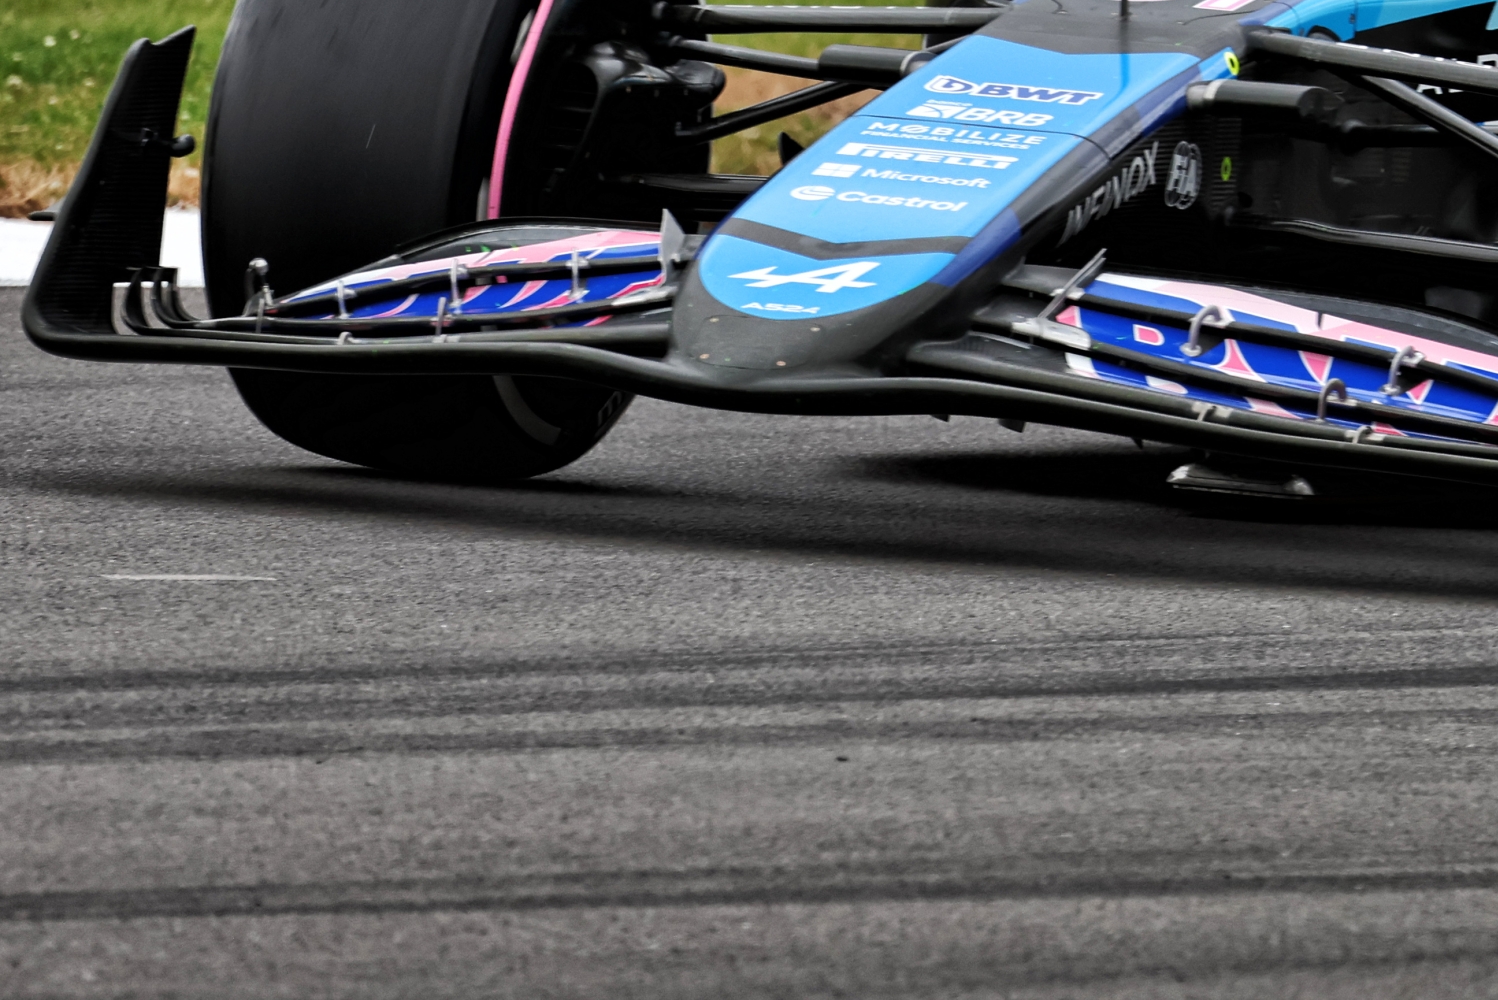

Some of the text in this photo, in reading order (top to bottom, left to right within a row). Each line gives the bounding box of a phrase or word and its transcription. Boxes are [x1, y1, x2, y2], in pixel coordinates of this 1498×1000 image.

[972, 82, 1104, 105] BWT
[953, 107, 1055, 127] BRB
[860, 130, 1031, 151] FINANCIAL SERVICES
[836, 142, 1020, 170] PIRELLI
[861, 168, 992, 189] Microsoft
[836, 190, 969, 212] Castrol
[740, 302, 821, 314] A524
